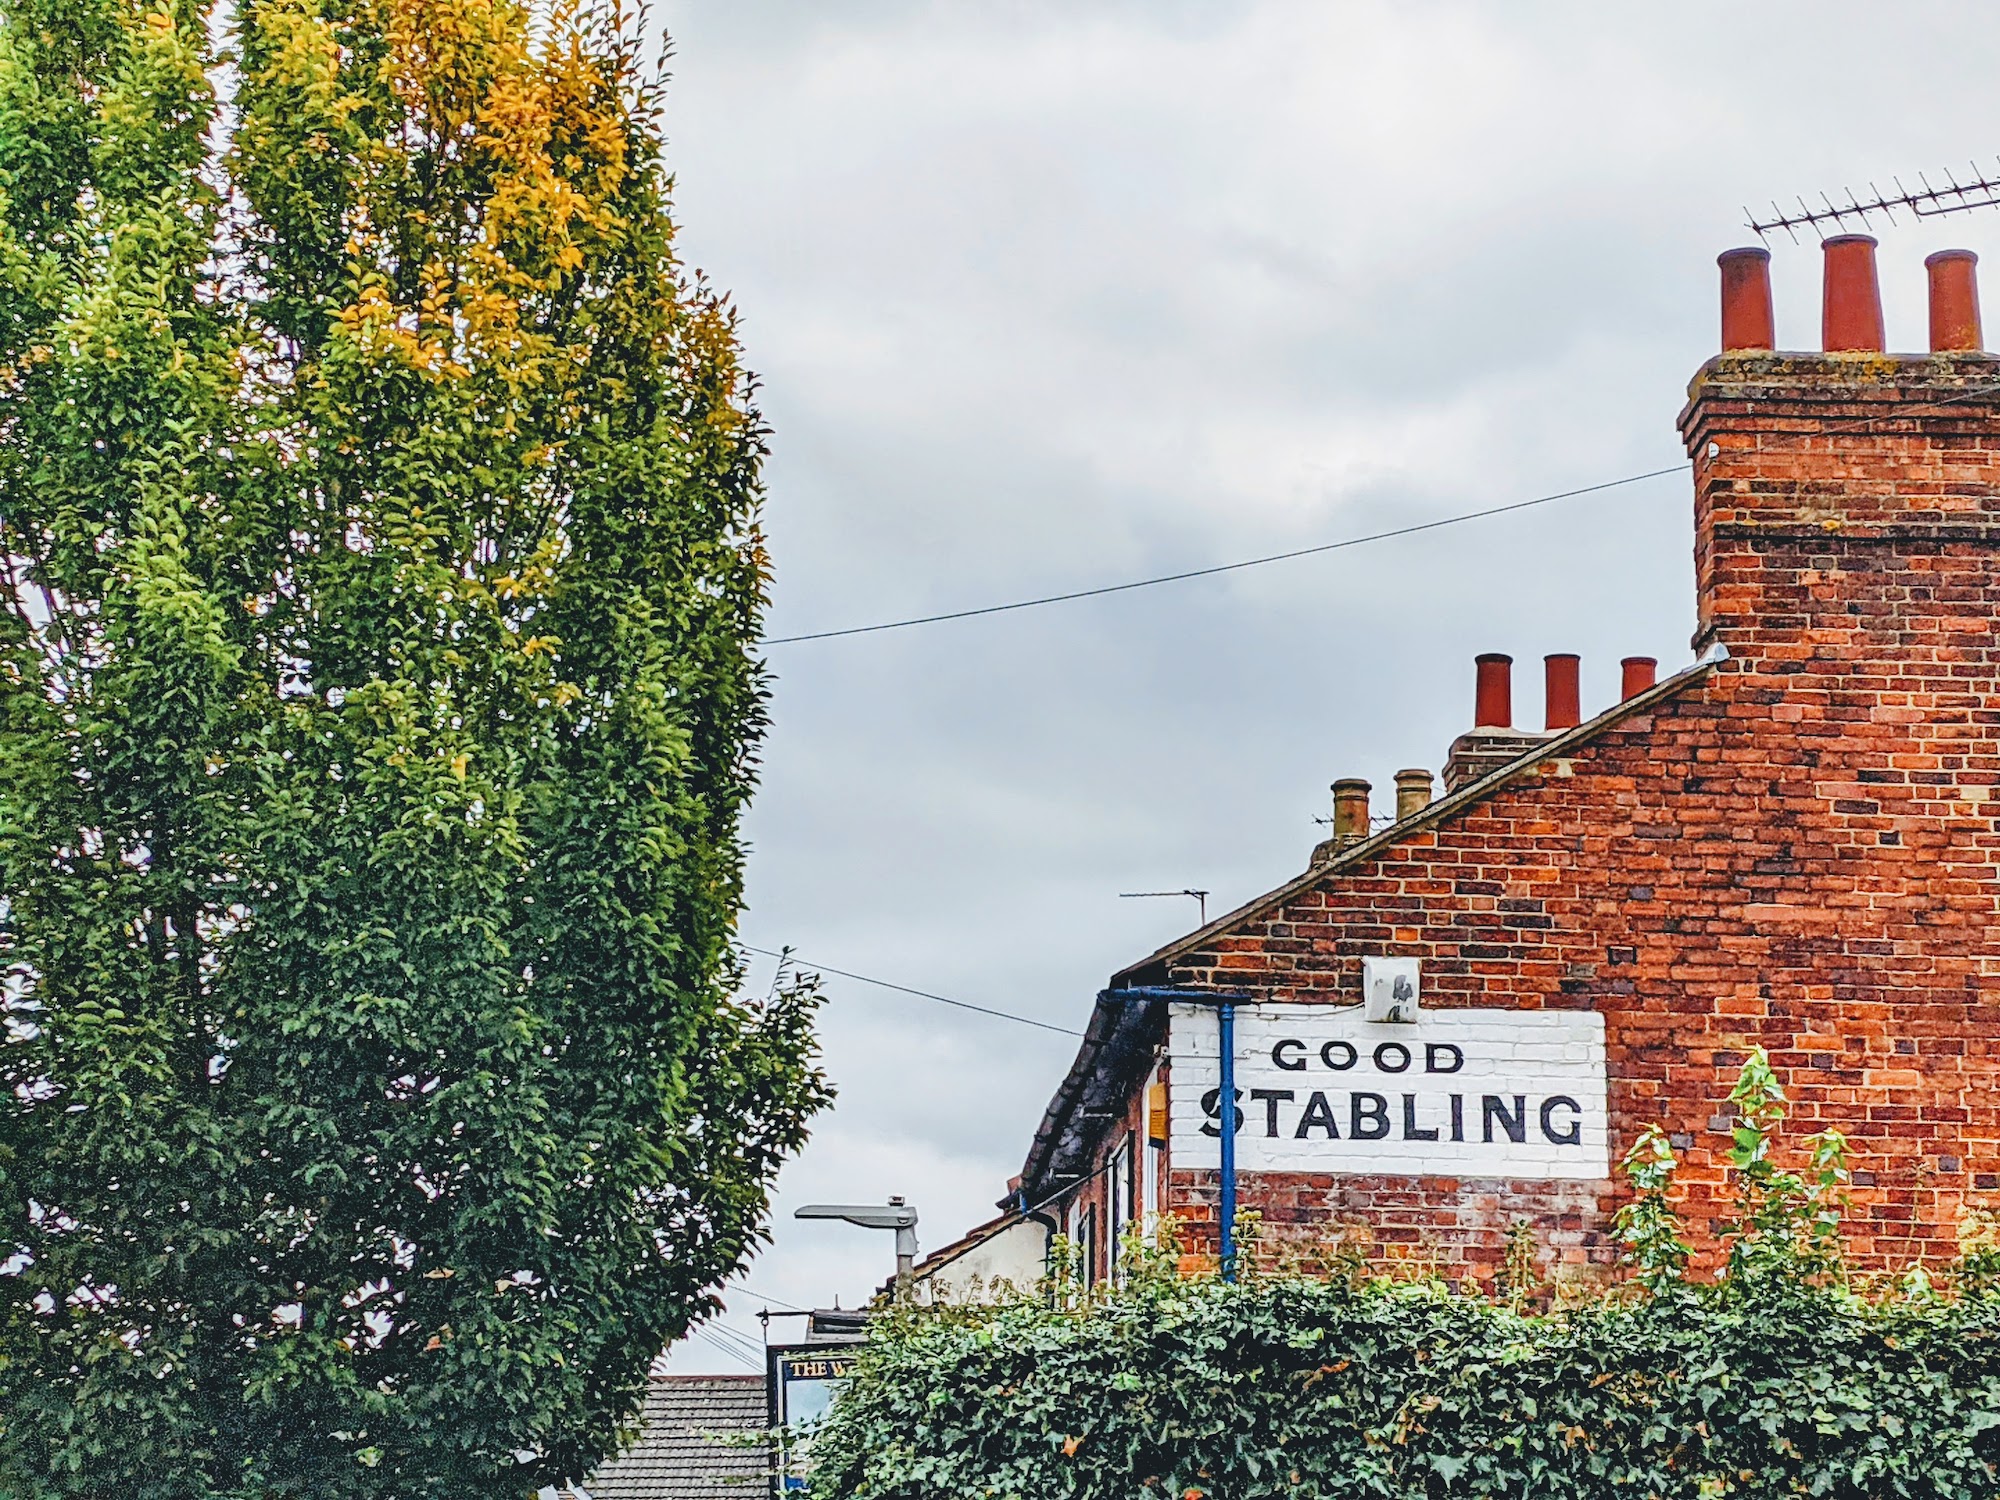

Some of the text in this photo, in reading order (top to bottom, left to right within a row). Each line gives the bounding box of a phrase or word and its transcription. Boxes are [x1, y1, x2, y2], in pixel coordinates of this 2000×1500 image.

[1271, 1038, 1464, 1074] GOOD
[1199, 1086, 1582, 1146] STABLING
[789, 1360, 828, 1377] THE
